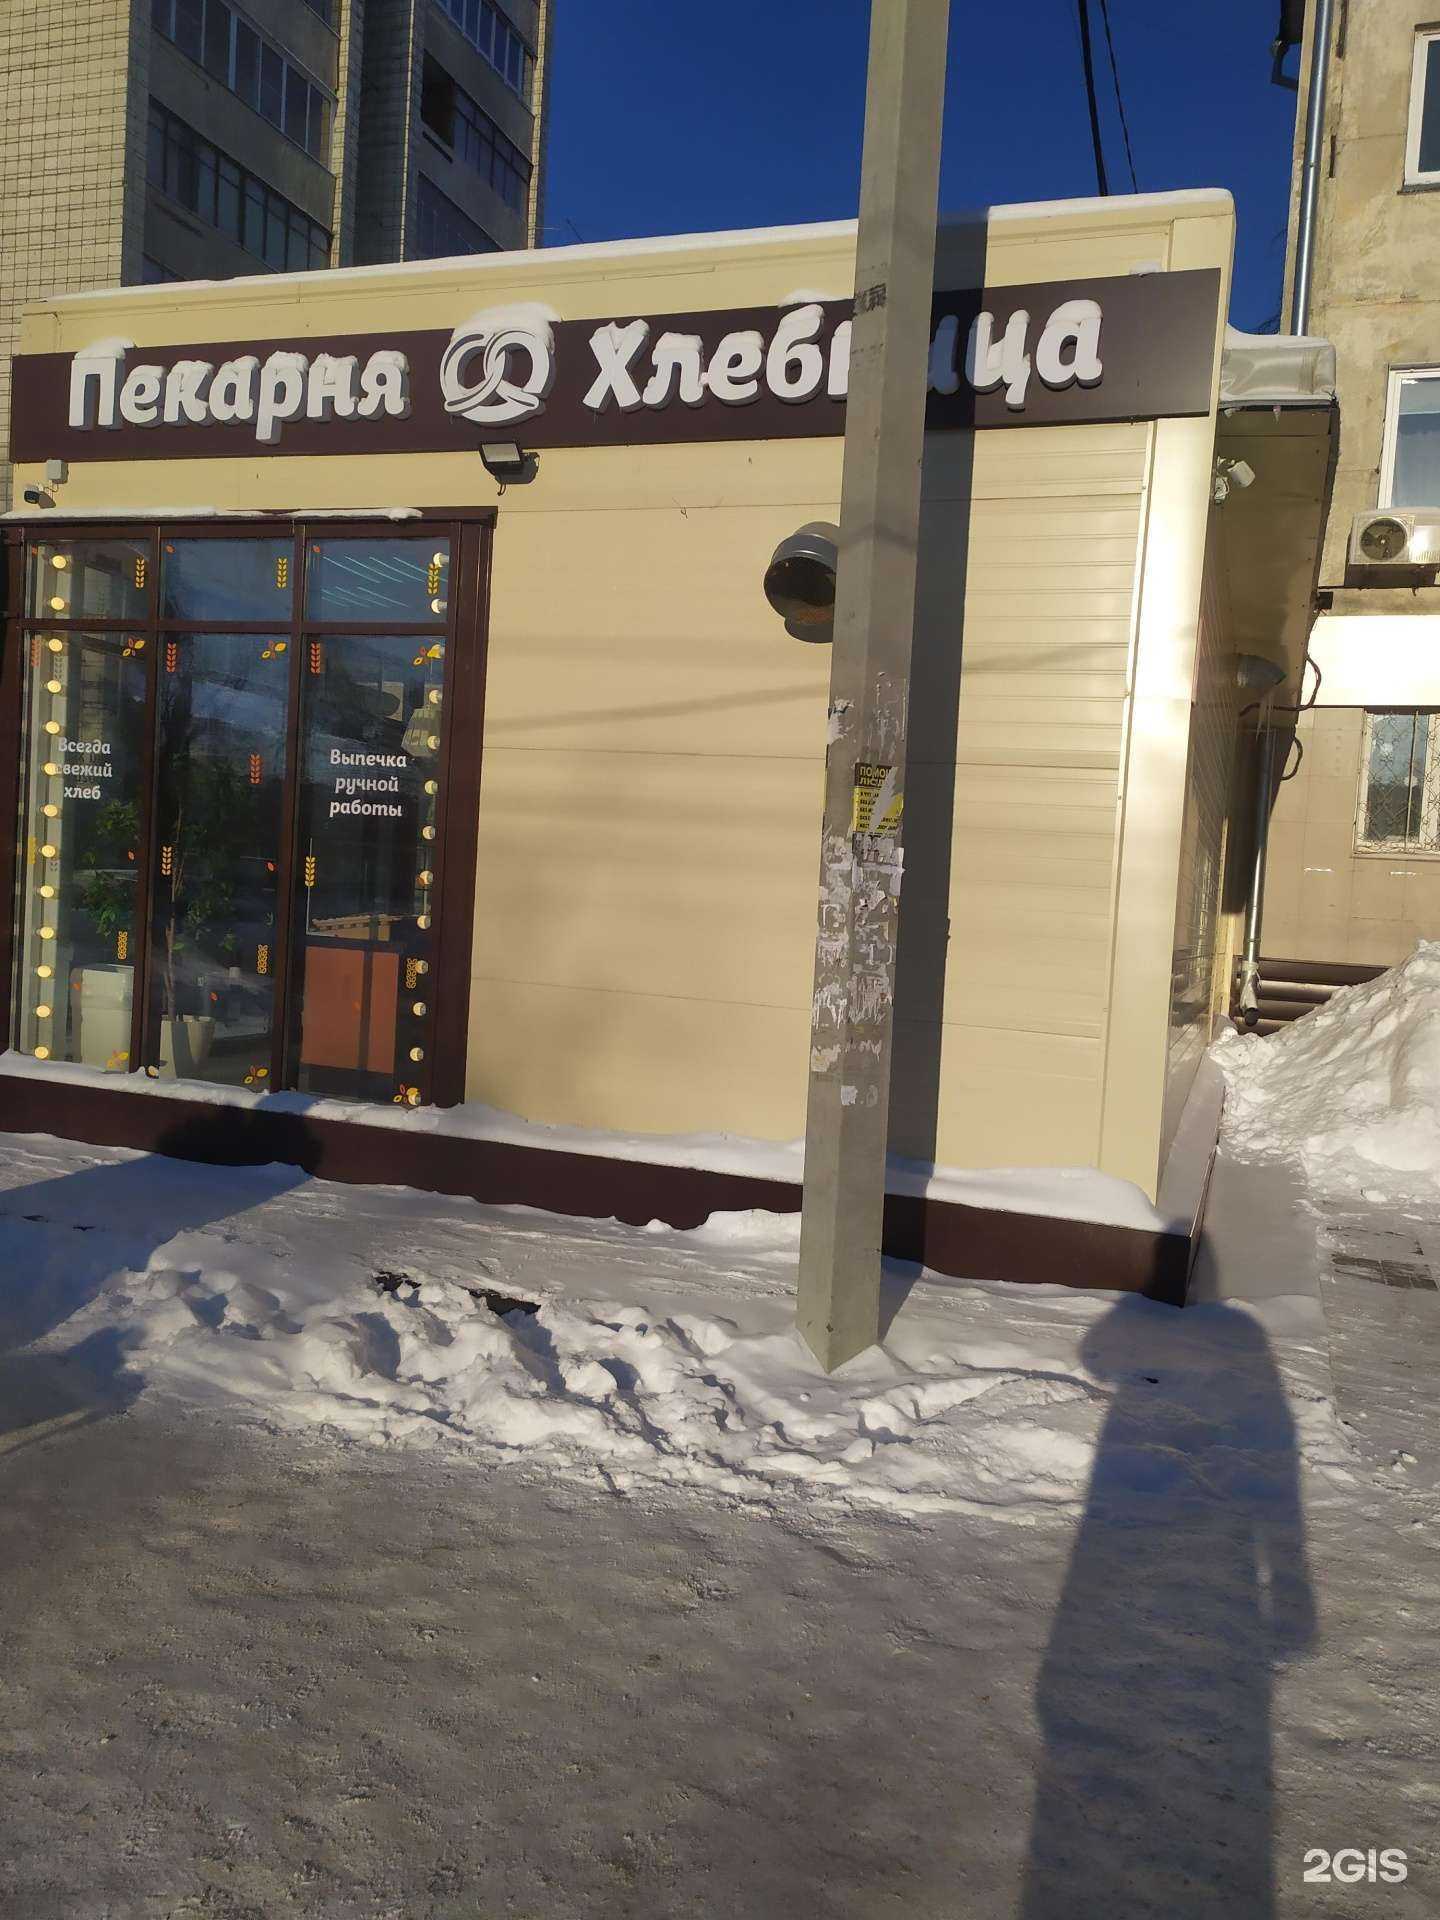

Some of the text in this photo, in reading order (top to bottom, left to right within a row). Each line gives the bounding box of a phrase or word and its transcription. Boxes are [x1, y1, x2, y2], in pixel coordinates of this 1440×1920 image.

[68, 352, 408, 442] Пекарня
[58, 737, 112, 754] Всегда
[330, 749, 407, 768] Выпечка
[64, 785, 101, 799] хлеб
[335, 776, 399, 795] ручной
[329, 799, 402, 818] работы
